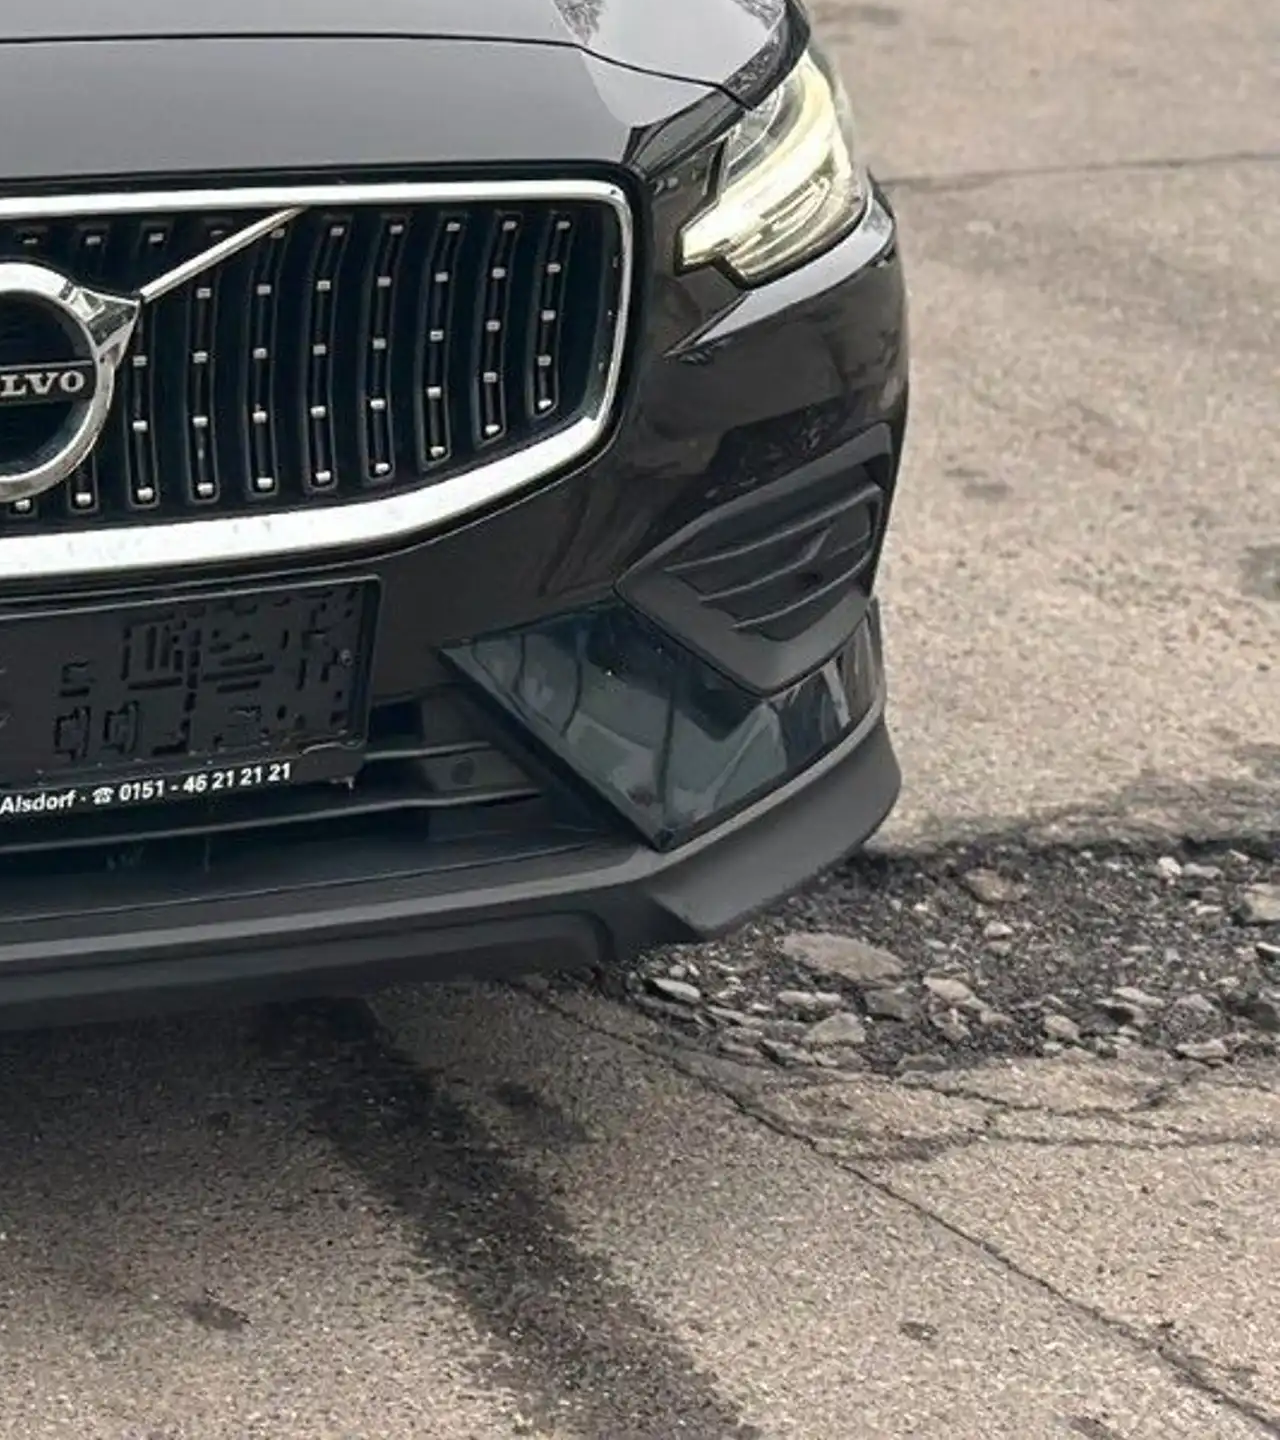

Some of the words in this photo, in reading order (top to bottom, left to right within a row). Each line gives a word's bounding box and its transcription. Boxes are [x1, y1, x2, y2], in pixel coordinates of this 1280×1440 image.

[118, 779, 165, 803] 0151
[211, 769, 236, 791] 21
[240, 765, 263, 788] 21
[267, 761, 291, 782] 21
